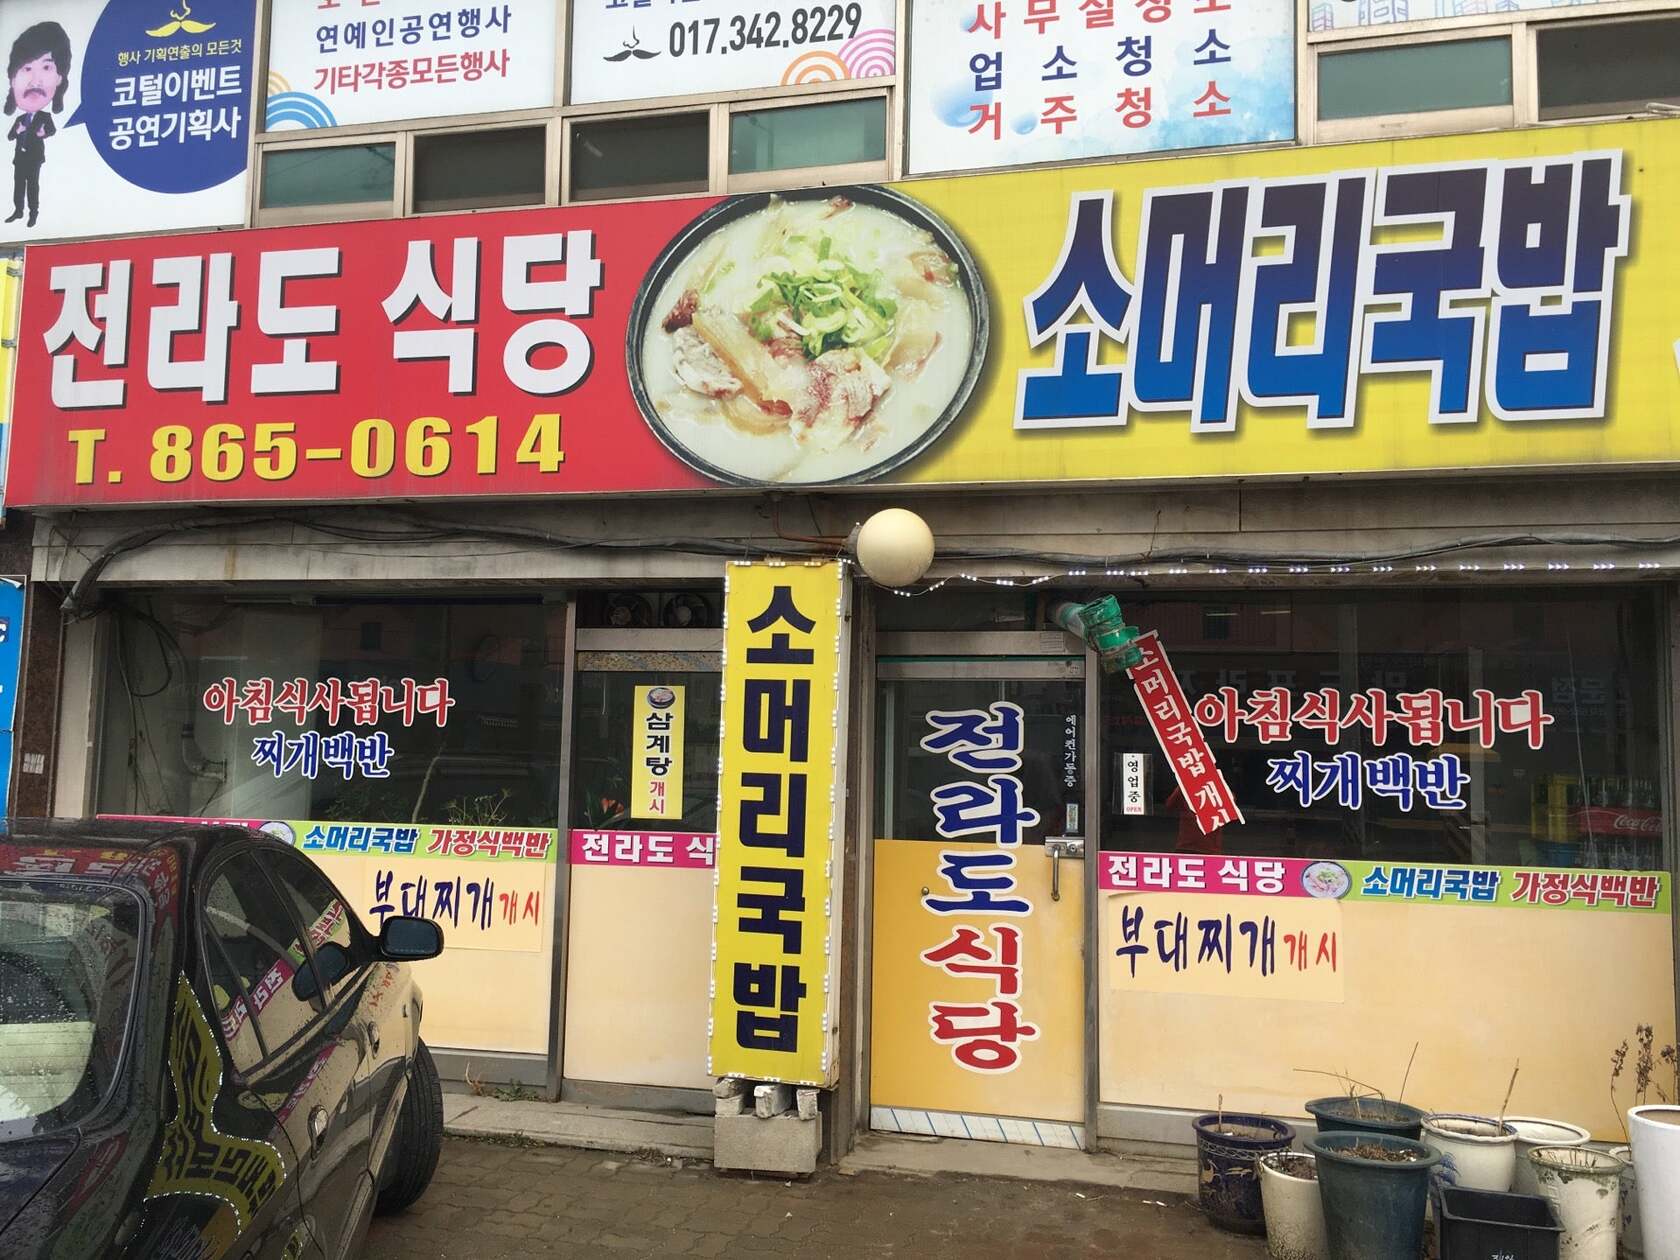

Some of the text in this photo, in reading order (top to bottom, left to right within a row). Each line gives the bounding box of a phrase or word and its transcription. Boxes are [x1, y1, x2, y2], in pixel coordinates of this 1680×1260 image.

[117, 39, 242, 67] 행사 기획연출의 모든것
[669, 2, 862, 57] 017.342.8229
[112, 65, 242, 107] 코털이벤트
[313, 48, 510, 95] 기타각종모든행사
[109, 106, 242, 150] 공연기획사
[1013, 149, 1631, 433] 소머리국밥
[43, 229, 602, 409] 전라도 식당
[67, 413, 566, 484] T. 865-0614
[203, 677, 455, 727] 아침식사됩니다
[1195, 686, 1555, 749] 아침식사됩니다
[251, 730, 395, 780] 찌개백반
[645, 711, 674, 777] 삼계탕
[1127, 760, 1141, 803] 영업중
[1265, 750, 1472, 812] 찌개백반
[303, 825, 550, 858] 소머리국밥 가정식백반
[732, 585, 817, 1053] 소머리국밥
[582, 834, 714, 866] 전라도 식
[1108, 855, 1285, 894] 전라도 식당
[1362, 865, 1659, 908] 소머리국밥 가정식백반
[1115, 905, 1337, 978] 부대찌개 개시
